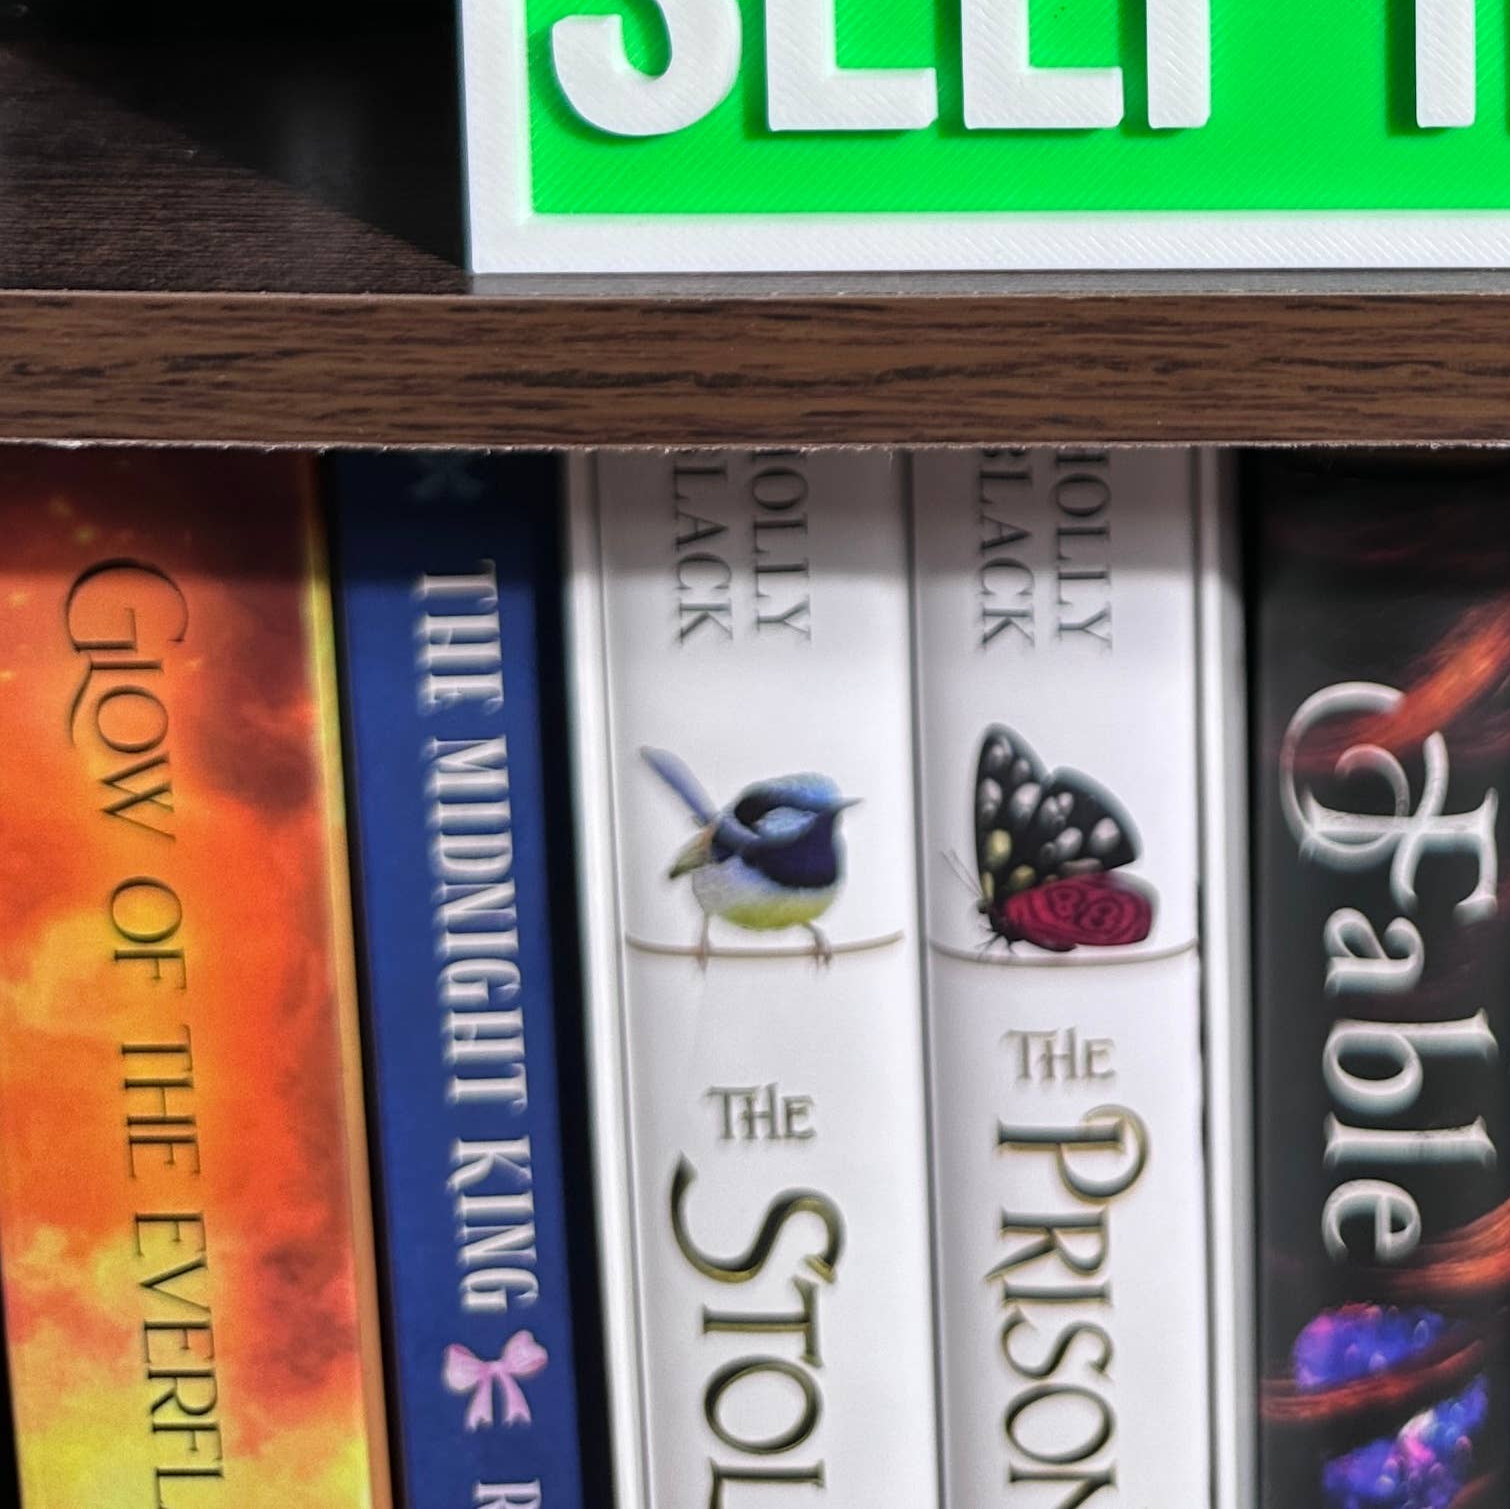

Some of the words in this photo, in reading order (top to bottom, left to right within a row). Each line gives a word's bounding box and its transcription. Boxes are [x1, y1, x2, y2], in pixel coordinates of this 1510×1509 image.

[672, 462, 733, 648] LACK
[750, 446, 812, 642] OLLY
[66, 556, 190, 842] GLOW
[414, 558, 504, 715] THE
[109, 876, 188, 992] OF
[422, 734, 528, 1114] MIDNIGHT
[1280, 681, 1498, 1262] Fable
[120, 1024, 202, 1180] THE
[705, 1082, 816, 1142] THE
[1003, 1028, 1116, 1082] THE
[446, 1136, 540, 1314] KING
[133, 1210, 225, 1509] EVERFL
